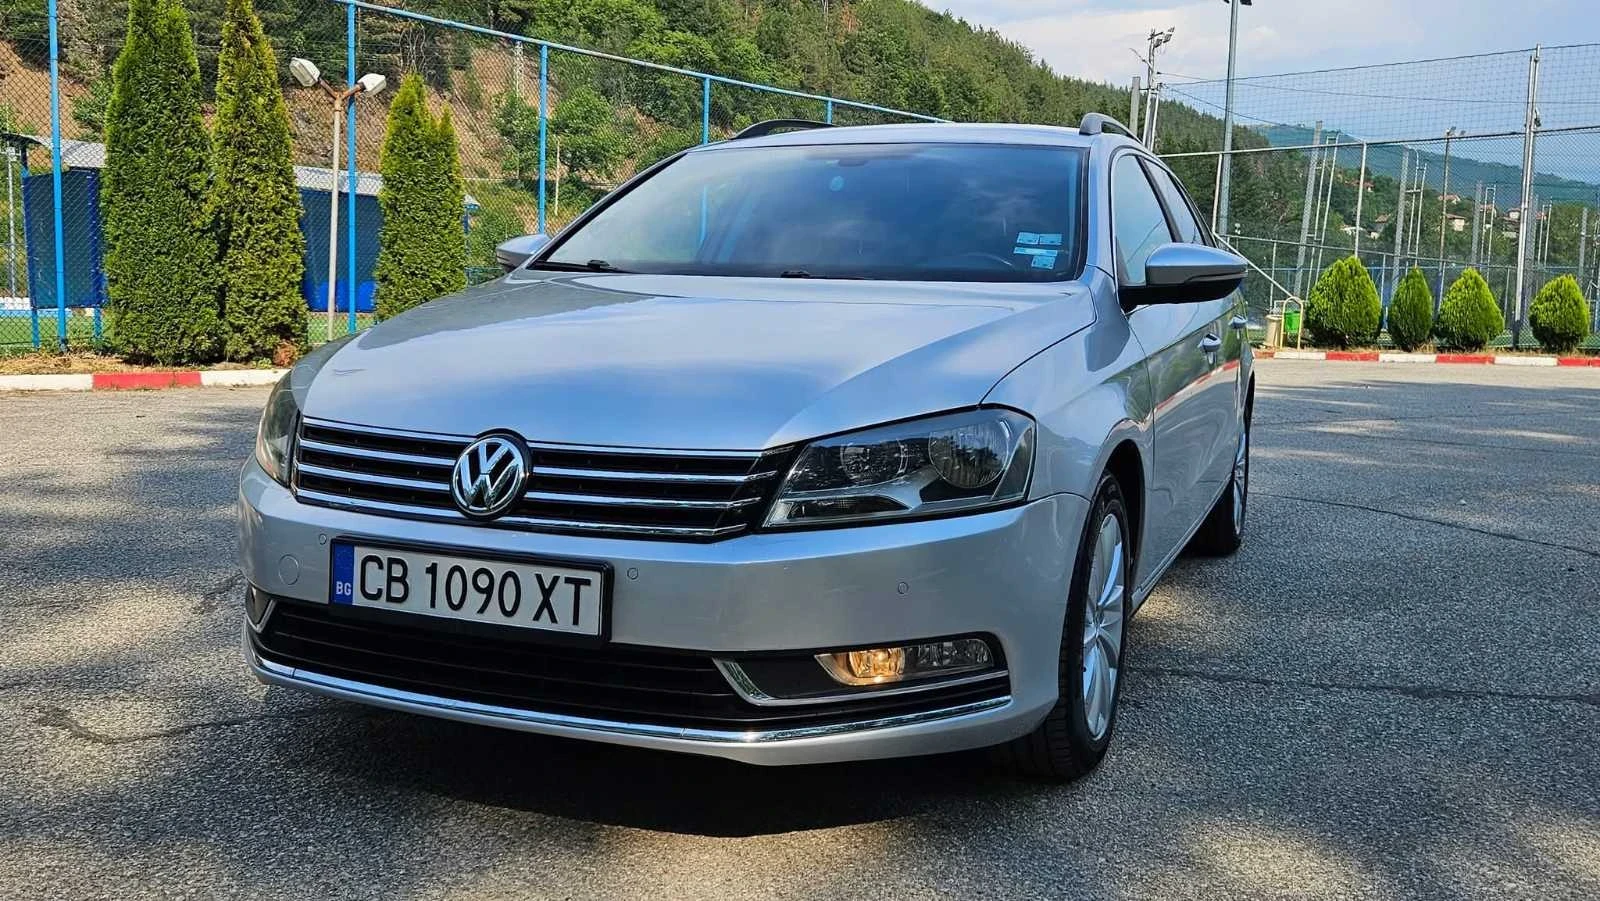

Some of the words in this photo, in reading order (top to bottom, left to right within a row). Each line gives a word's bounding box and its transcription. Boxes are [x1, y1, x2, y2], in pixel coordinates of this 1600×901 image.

[335, 580, 352, 596] BG
[360, 554, 409, 604] CB
[425, 562, 522, 618] 1090
[533, 572, 592, 626] XT
